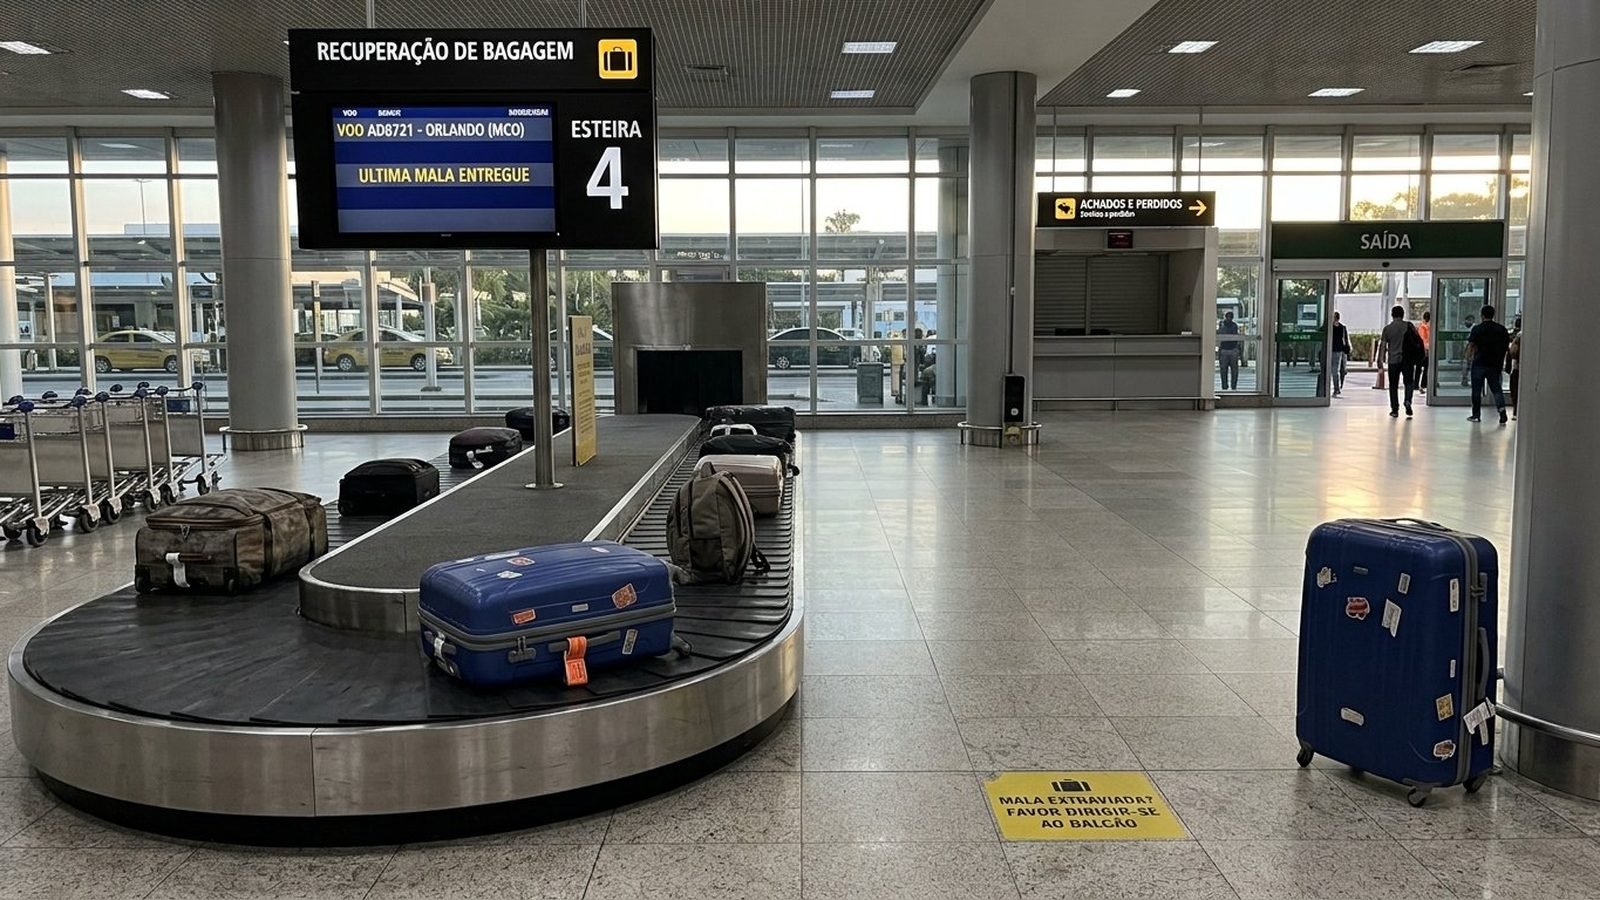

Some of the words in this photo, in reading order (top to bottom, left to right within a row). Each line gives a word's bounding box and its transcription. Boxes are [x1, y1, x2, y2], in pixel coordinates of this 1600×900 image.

[317, 38, 448, 65] RECUPERAÇÃO
[454, 42, 478, 60] DE
[483, 41, 574, 60] BAGAGEM
[337, 123, 364, 137] VOO
[367, 123, 413, 137] AD8721
[425, 123, 485, 137] ORLANDO
[488, 122, 525, 139] (MCO)
[571, 120, 642, 139] ESTEIRA
[359, 168, 411, 183] ULTIMA
[415, 168, 455, 183] MALA
[459, 168, 530, 182] ENTREGUE
[586, 147, 629, 210] 4
[1080, 199, 1126, 209] ACHADOS
[1127, 199, 1134, 209] E
[1136, 199, 1183, 209] PERDIDOS
[1360, 231, 1412, 250] SAÍDA
[999, 796, 1044, 805] MALA
[1007, 808, 1061, 816] FAVOR
[1066, 808, 1160, 817] DIRIGIR-SE
[1041, 819, 1064, 828] AO
[1070, 818, 1137, 828] BALCÃO
